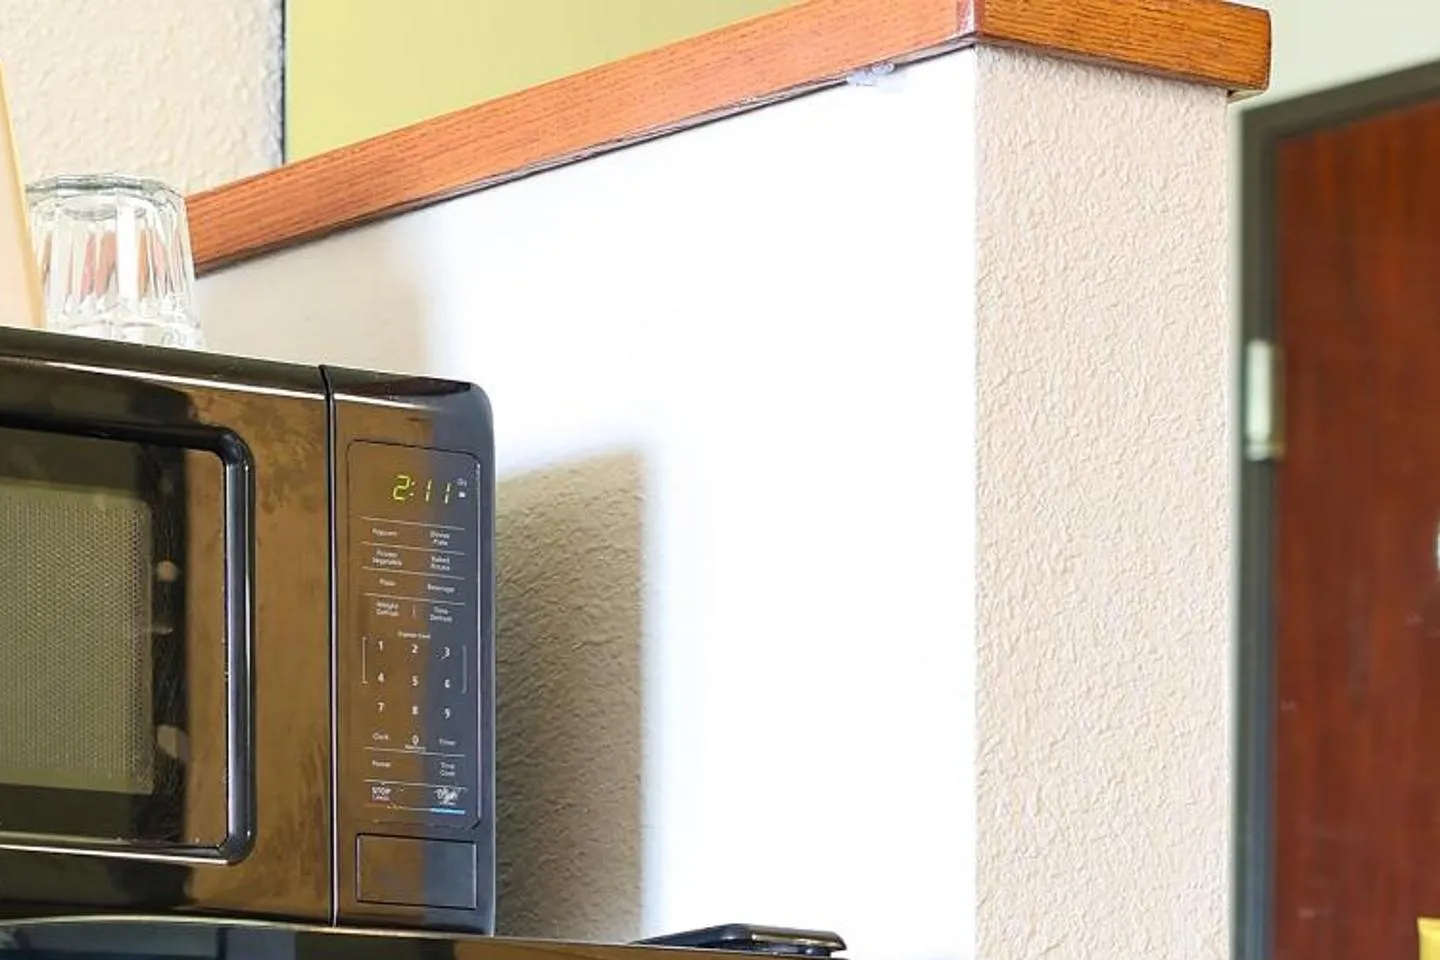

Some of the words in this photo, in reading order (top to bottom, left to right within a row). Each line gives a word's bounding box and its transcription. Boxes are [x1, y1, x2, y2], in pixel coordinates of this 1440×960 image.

[392, 474, 451, 504] 2:11
[411, 644, 419, 654] 2
[377, 701, 385, 713] 7
